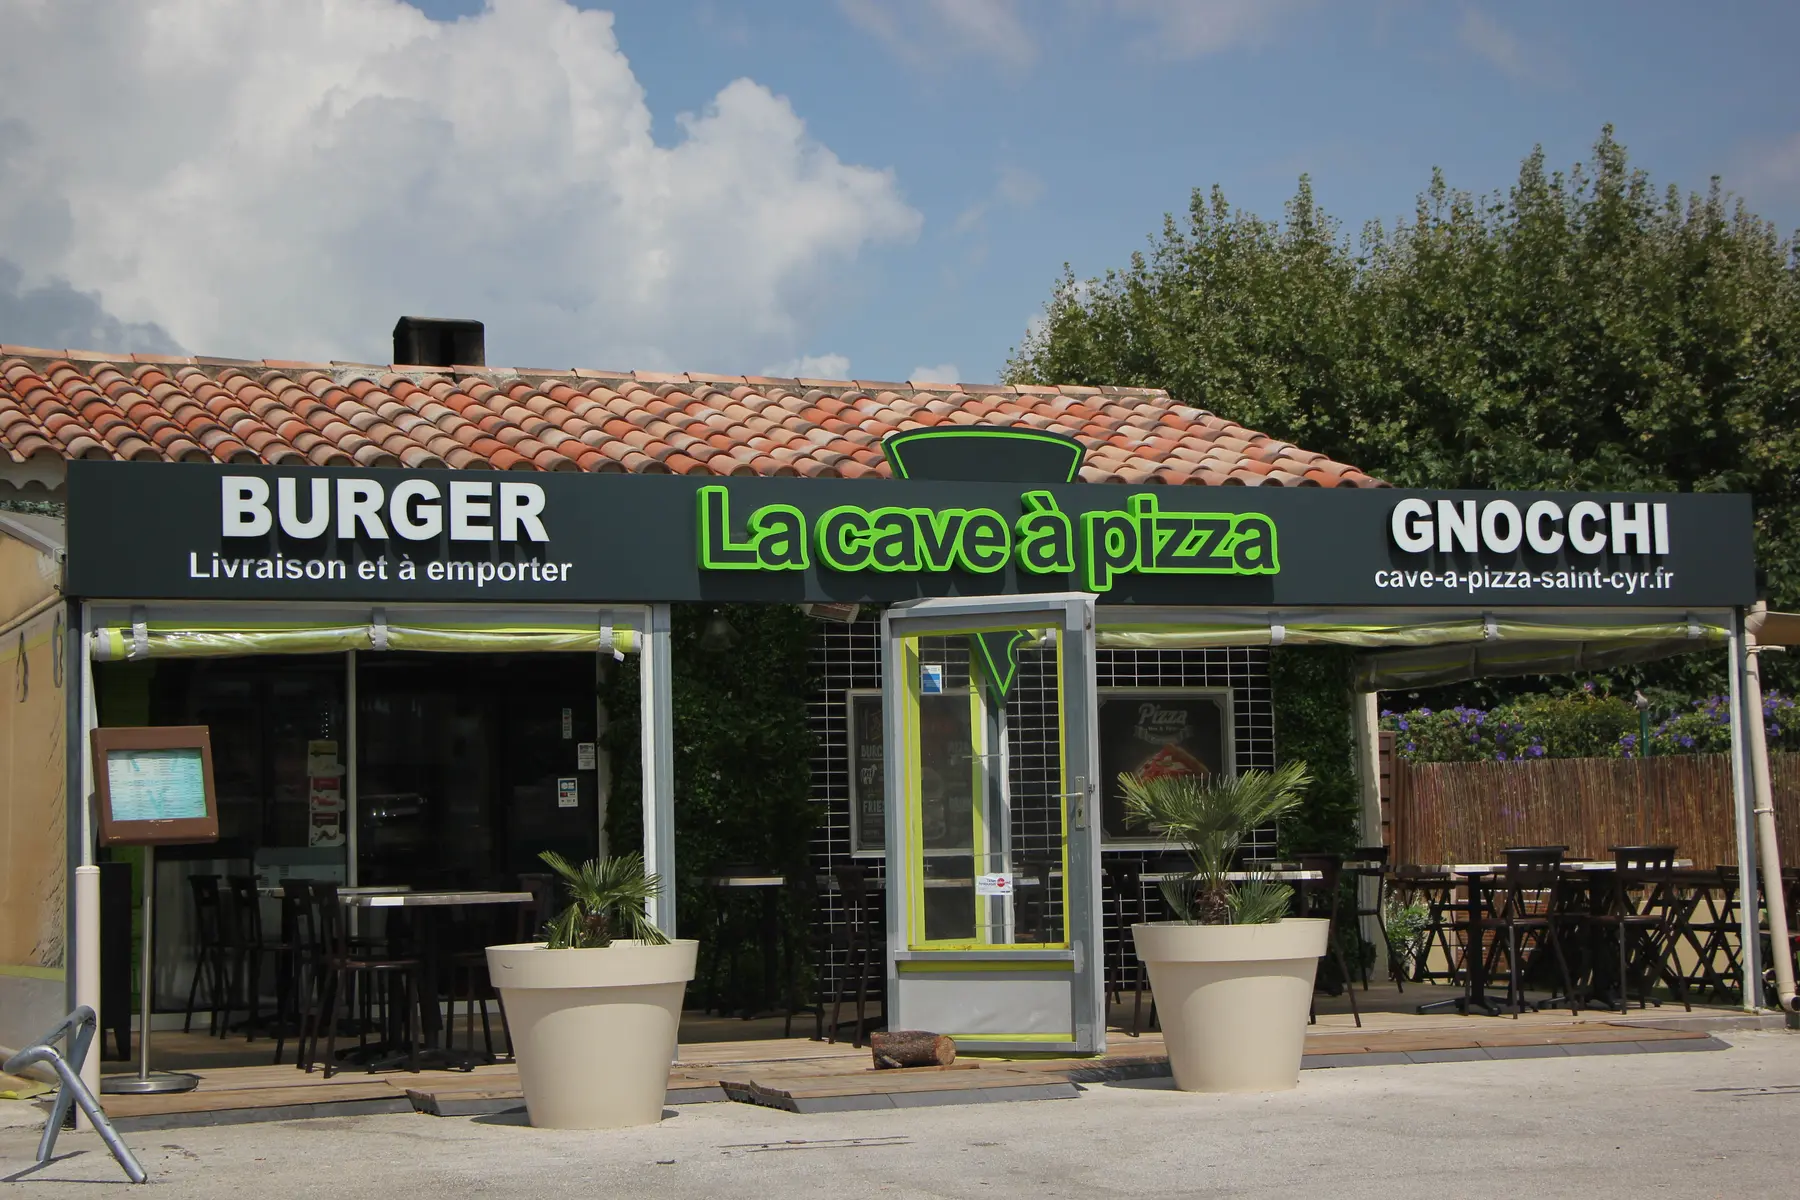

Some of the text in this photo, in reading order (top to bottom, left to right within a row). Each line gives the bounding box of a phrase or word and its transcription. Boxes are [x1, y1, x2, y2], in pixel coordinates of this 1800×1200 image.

[222, 476, 550, 542] BURGER
[1391, 498, 1669, 555] GNOCCHI
[699, 485, 1280, 592] La cave à pizza
[189, 552, 573, 587] Livraison et à emporter
[1374, 565, 1674, 594] cave-a-pizza-saint-cyr.fr
[1138, 702, 1188, 726] Pizza
